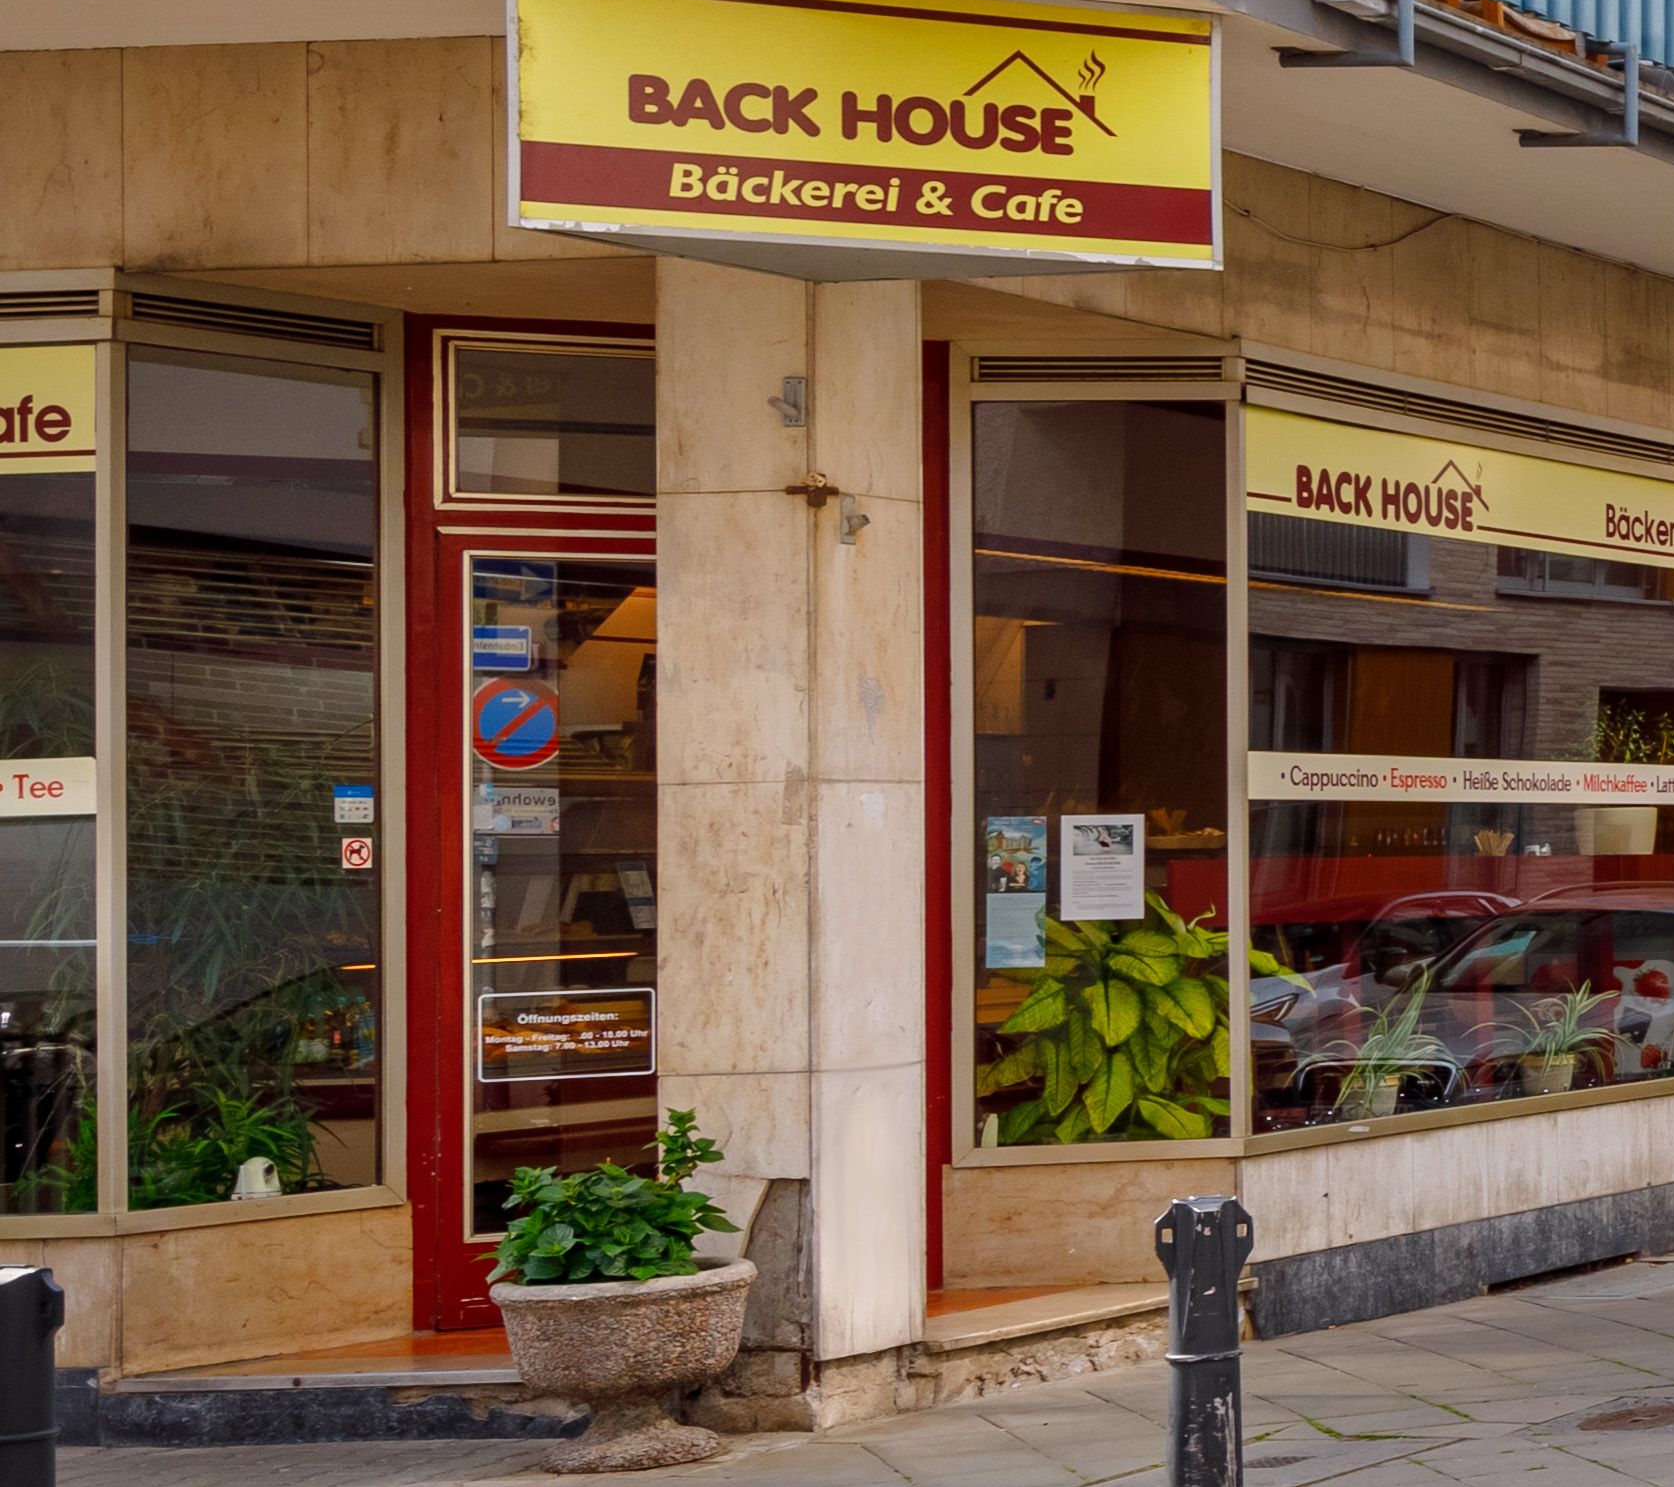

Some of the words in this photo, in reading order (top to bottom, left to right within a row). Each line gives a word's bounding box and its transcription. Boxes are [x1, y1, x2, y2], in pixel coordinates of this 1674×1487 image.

[628, 74, 820, 137] BACK
[842, 90, 1074, 156] HOUSE
[668, 162, 899, 212] Bäckerei
[915, 181, 953, 216] &
[970, 184, 1083, 224] Cafe
[1296, 464, 1372, 517] BACK
[1381, 478, 1474, 532] HOUSE
[12, 774, 64, 799] Tee
[1290, 765, 1379, 791] Cappuccino
[1390, 768, 1447, 792] Espresso
[1463, 771, 1499, 791] Heiße
[1502, 772, 1572, 793] Schokolade
[1583, 773, 1648, 793] Milchkaffee
[517, 1012, 619, 1024] Öffnungszeiten:
[485, 1036, 523, 1045] Montag
[531, 1033, 570, 1042] Freitag:
[629, 1029, 648, 1038] Uhr
[505, 1043, 553, 1053] Samstag:
[611, 1039, 629, 1048] Uhr
